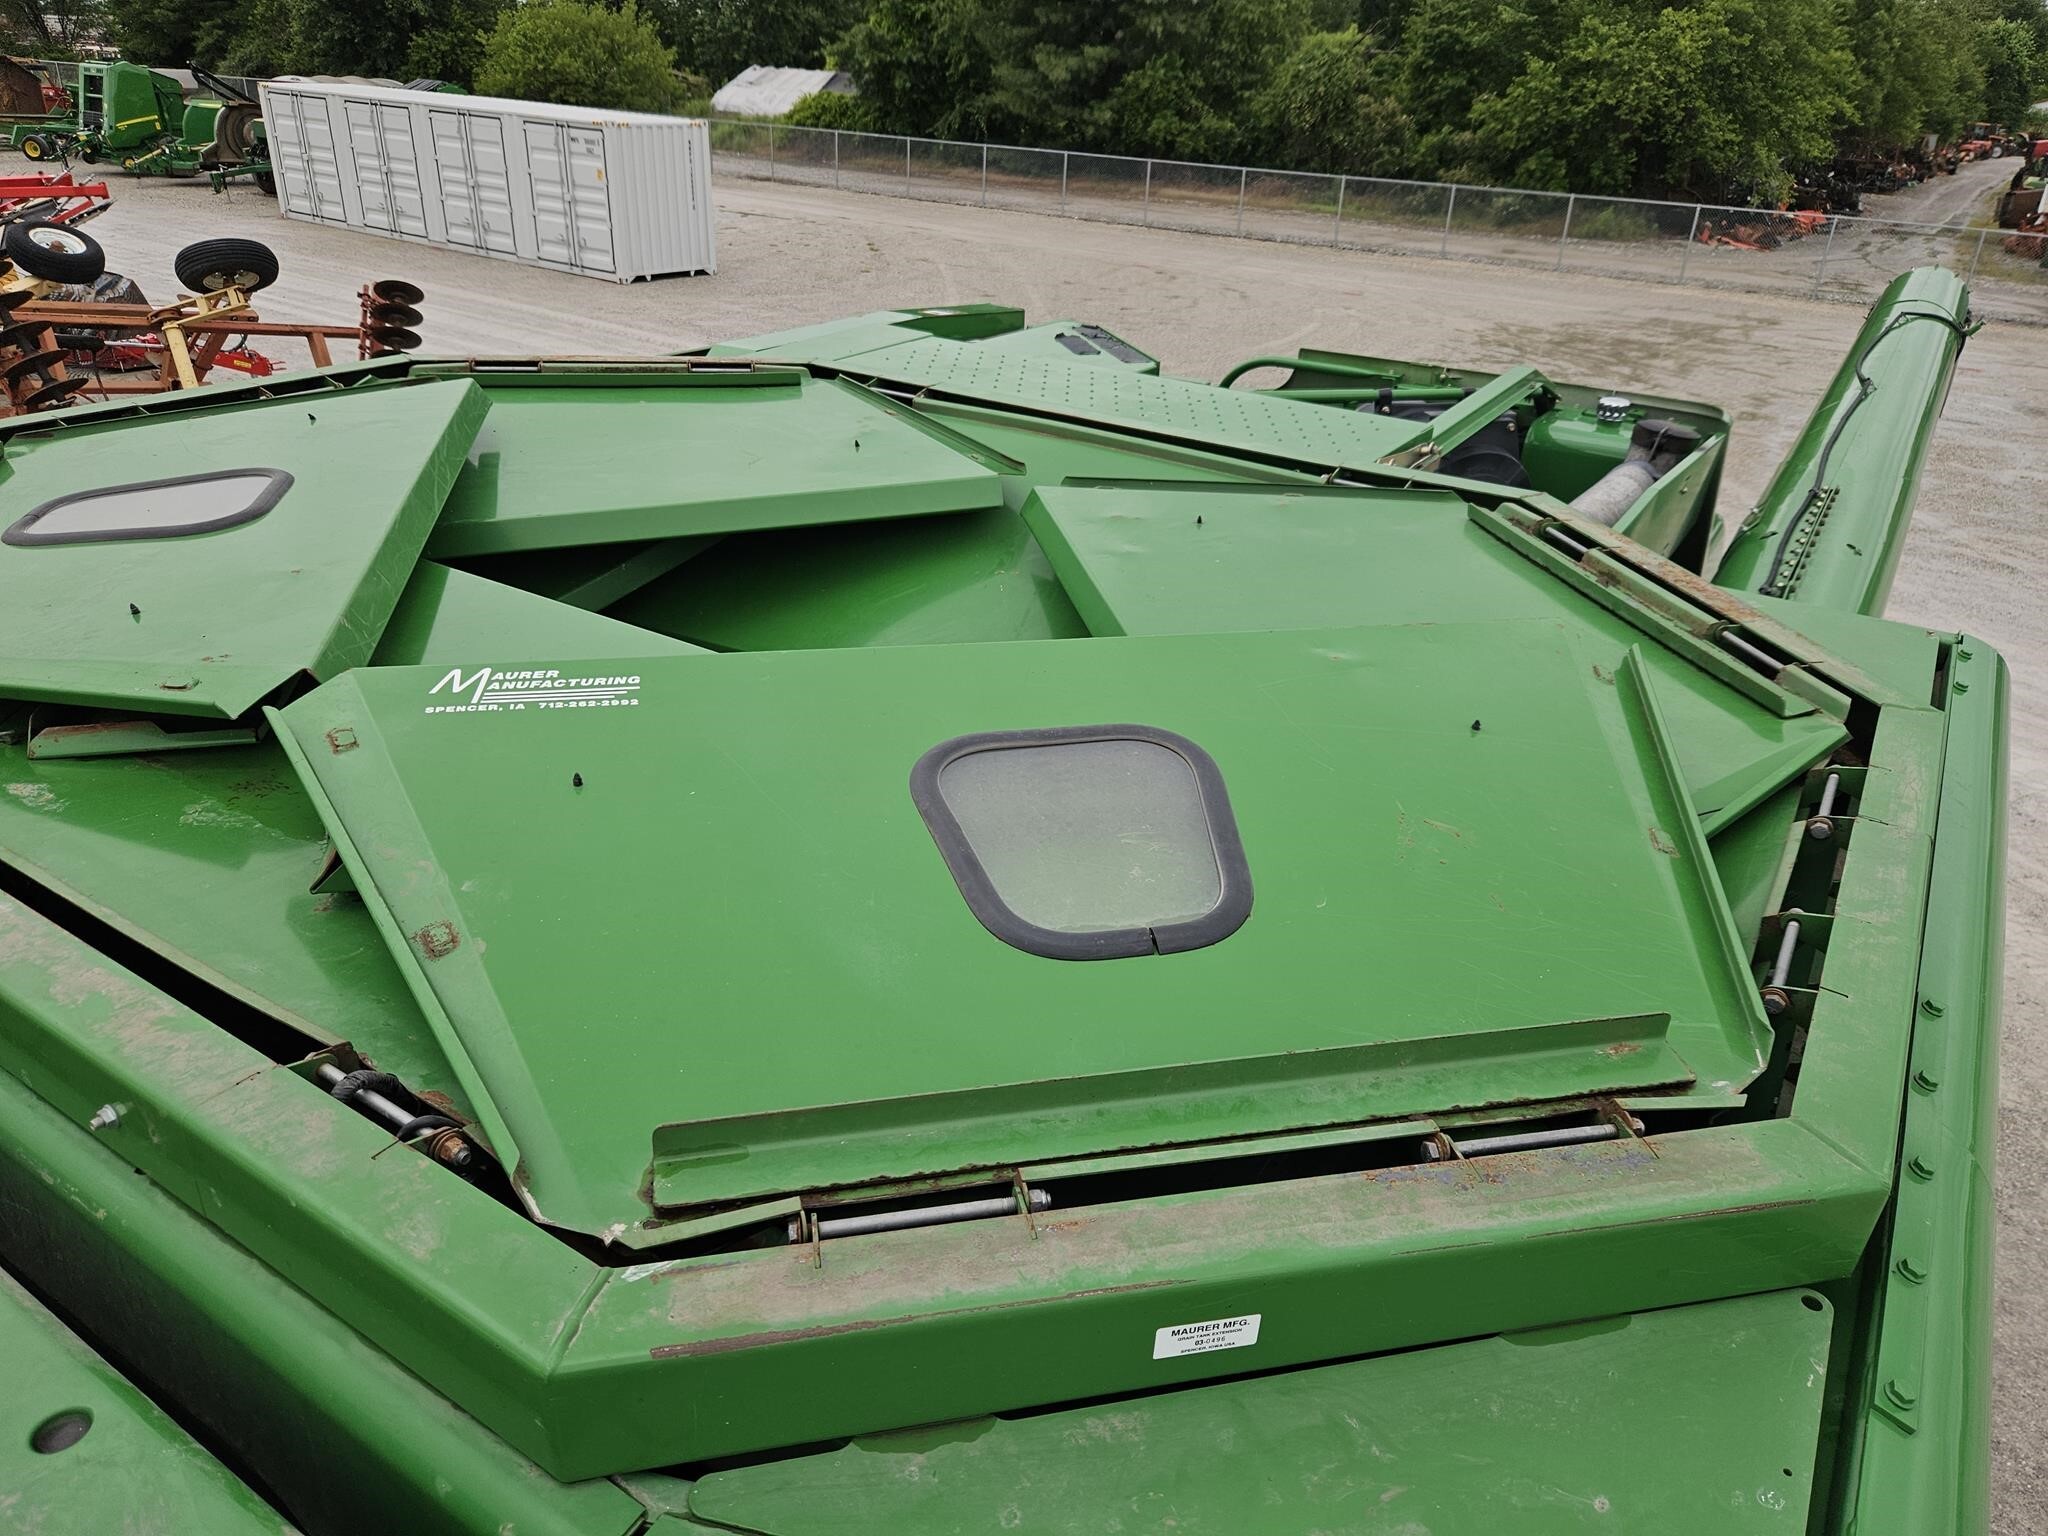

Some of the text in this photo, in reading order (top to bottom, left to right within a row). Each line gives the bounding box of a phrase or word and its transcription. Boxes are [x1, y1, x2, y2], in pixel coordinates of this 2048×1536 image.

[425, 704, 503, 714] SPENCER,
[538, 699, 639, 709] 712-262-2992
[1171, 1319, 1250, 1337] MAURER MFG.
[1212, 1328, 1243, 1336] EXTENSION
